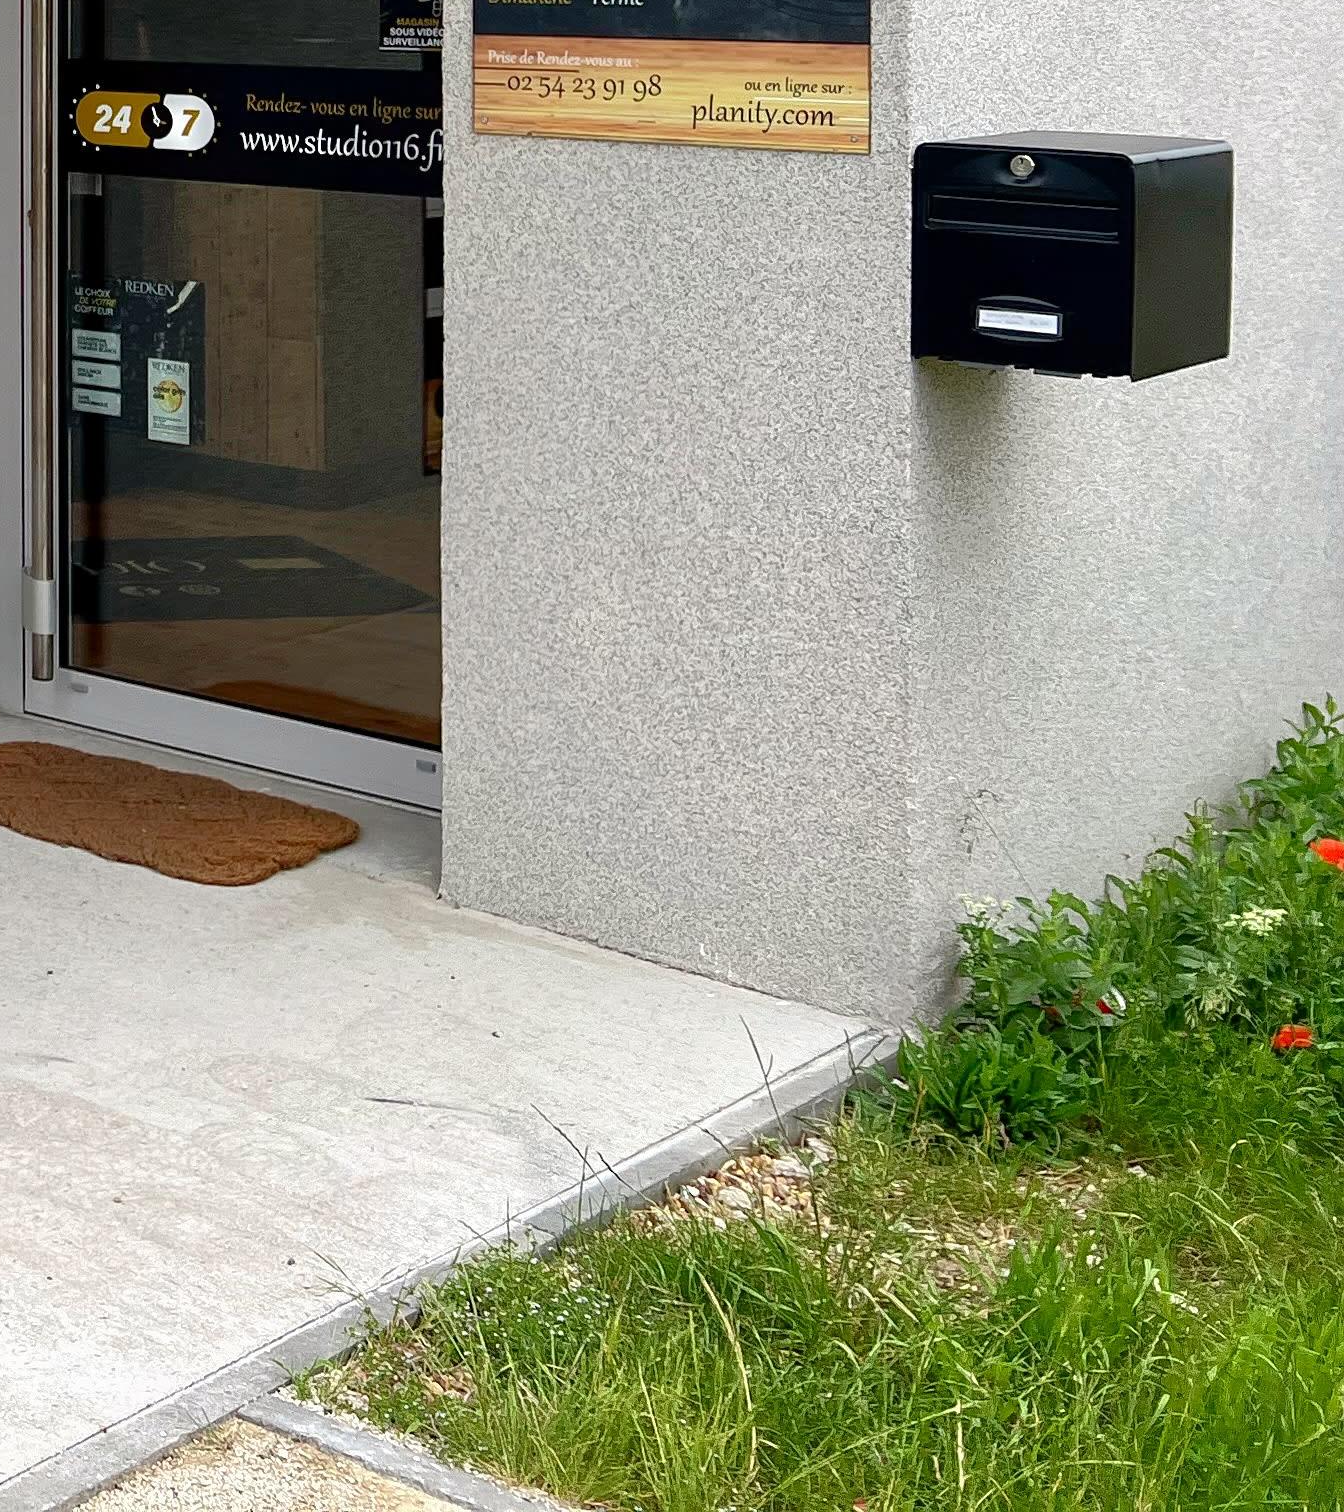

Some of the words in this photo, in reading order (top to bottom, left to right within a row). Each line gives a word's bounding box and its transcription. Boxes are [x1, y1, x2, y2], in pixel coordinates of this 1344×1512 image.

[390, 27, 414, 36] SOUS
[397, 18, 439, 26] MAGASIN
[488, 49, 517, 64] Prise
[519, 48, 533, 65] de
[537, 50, 613, 66] Rendez-vous
[616, 58, 632, 68] au
[507, 75, 533, 91] 02
[538, 75, 566, 99] 54
[572, 77, 596, 100] 23
[602, 78, 625, 101] 91
[632, 74, 662, 102] 98
[744, 79, 762, 91] ou
[764, 80, 782, 92] en
[785, 76, 822, 98] ligne
[824, 83, 846, 94] sur
[93, 104, 132, 134] 24
[181, 109, 200, 137] 7
[311, 102, 345, 117] vous
[350, 104, 367, 118] en
[372, 96, 411, 128] ligne
[415, 107, 442, 120] sur
[691, 93, 836, 133] planity.com
[125, 279, 176, 297] REDKEN
